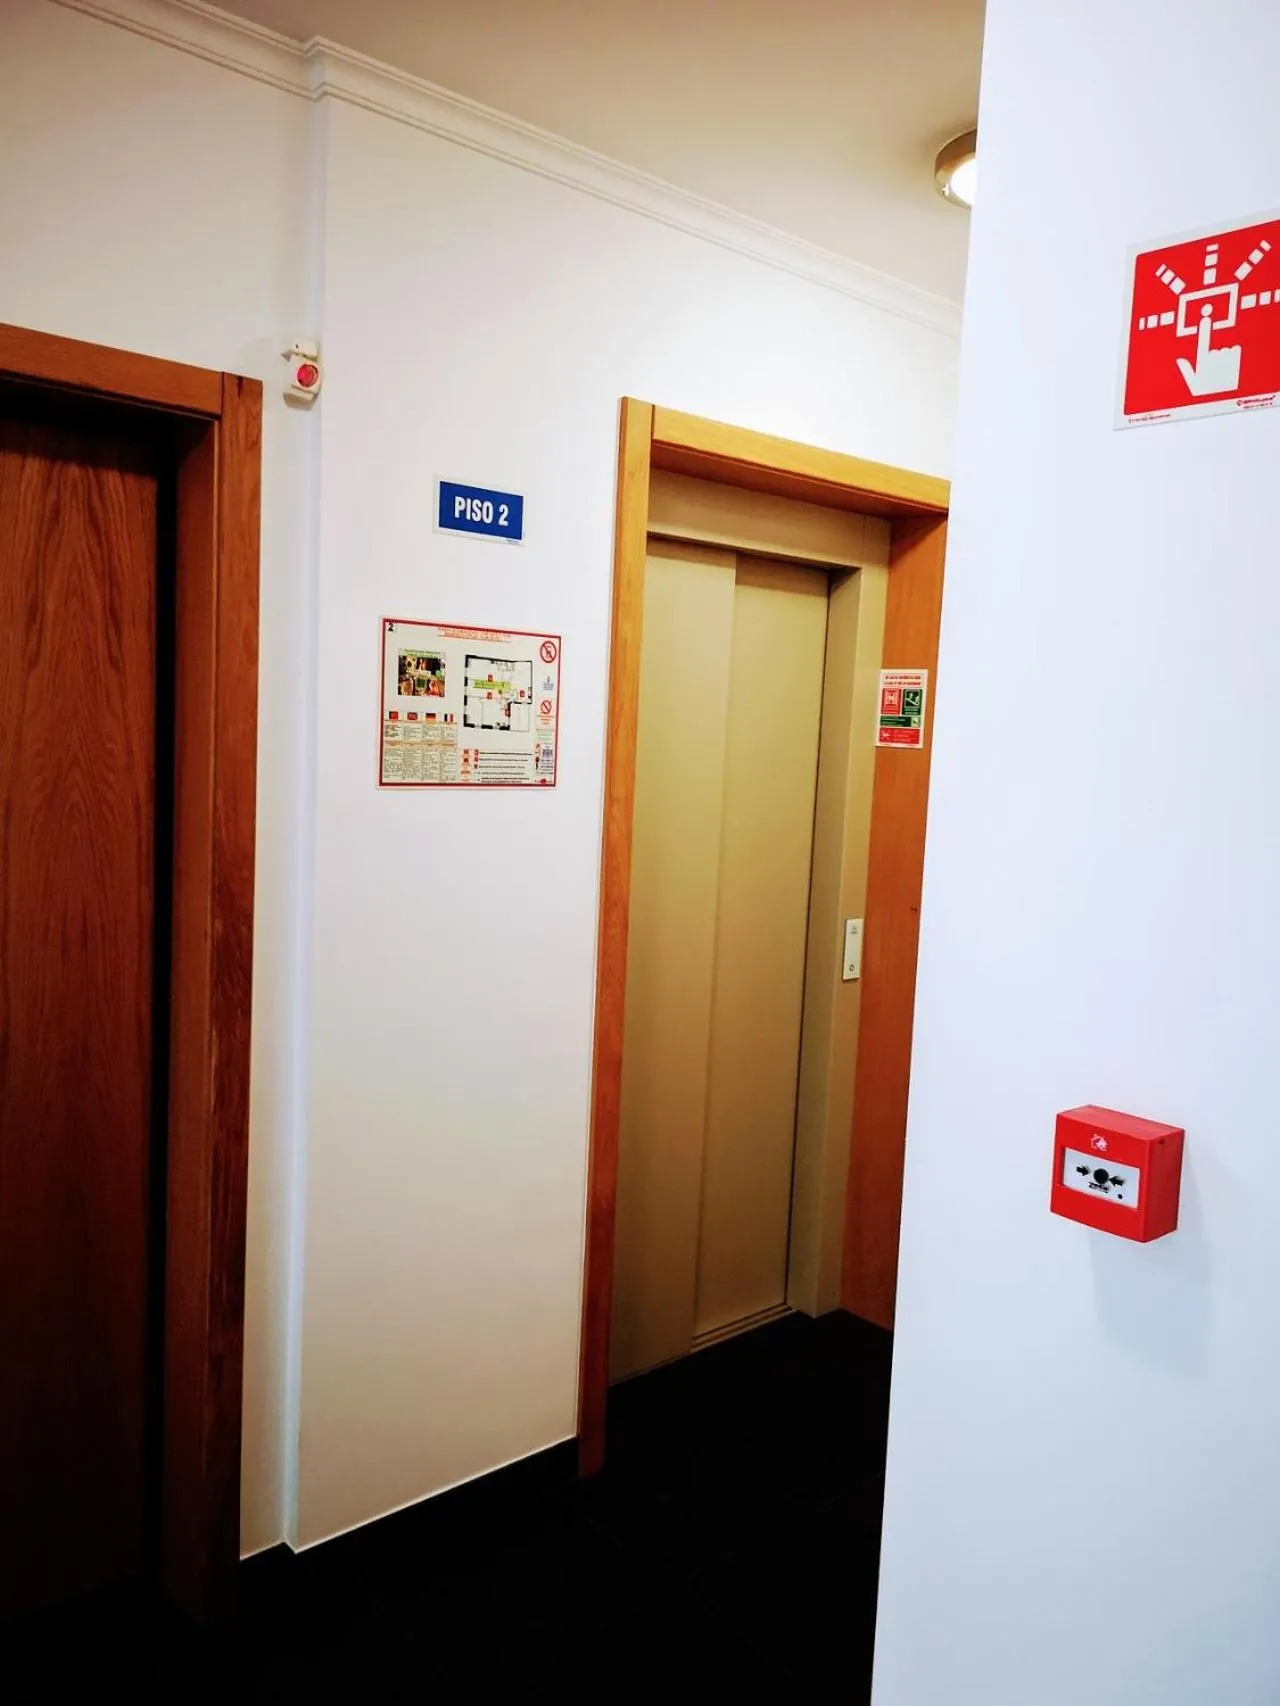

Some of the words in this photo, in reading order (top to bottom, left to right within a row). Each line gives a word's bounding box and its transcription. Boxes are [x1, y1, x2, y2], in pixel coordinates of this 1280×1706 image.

[454, 495, 494, 524] PISO
[498, 503, 509, 527] 2
[387, 622, 395, 632] 2
